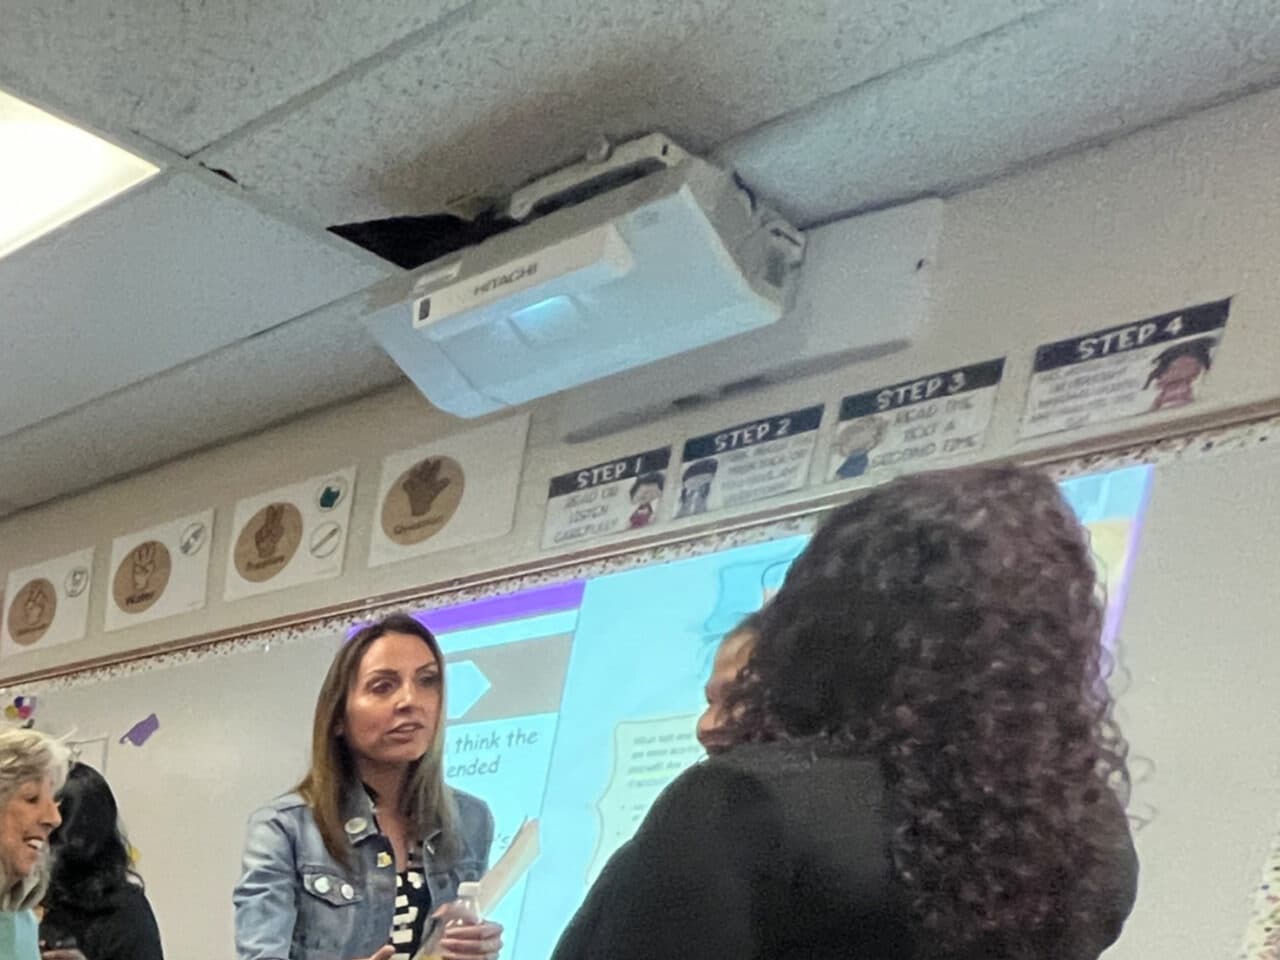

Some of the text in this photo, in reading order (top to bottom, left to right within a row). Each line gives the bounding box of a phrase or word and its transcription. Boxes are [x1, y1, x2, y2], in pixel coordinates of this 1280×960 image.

[473, 263, 538, 296] HITACHI
[1076, 315, 1183, 359] STEP 4
[876, 372, 966, 410] STEP 3
[894, 404, 937, 425] READ
[714, 418, 791, 452] STEP 2
[872, 434, 978, 464] SECOND TIME
[576, 461, 627, 489] STEP
[455, 728, 539, 754] think the
